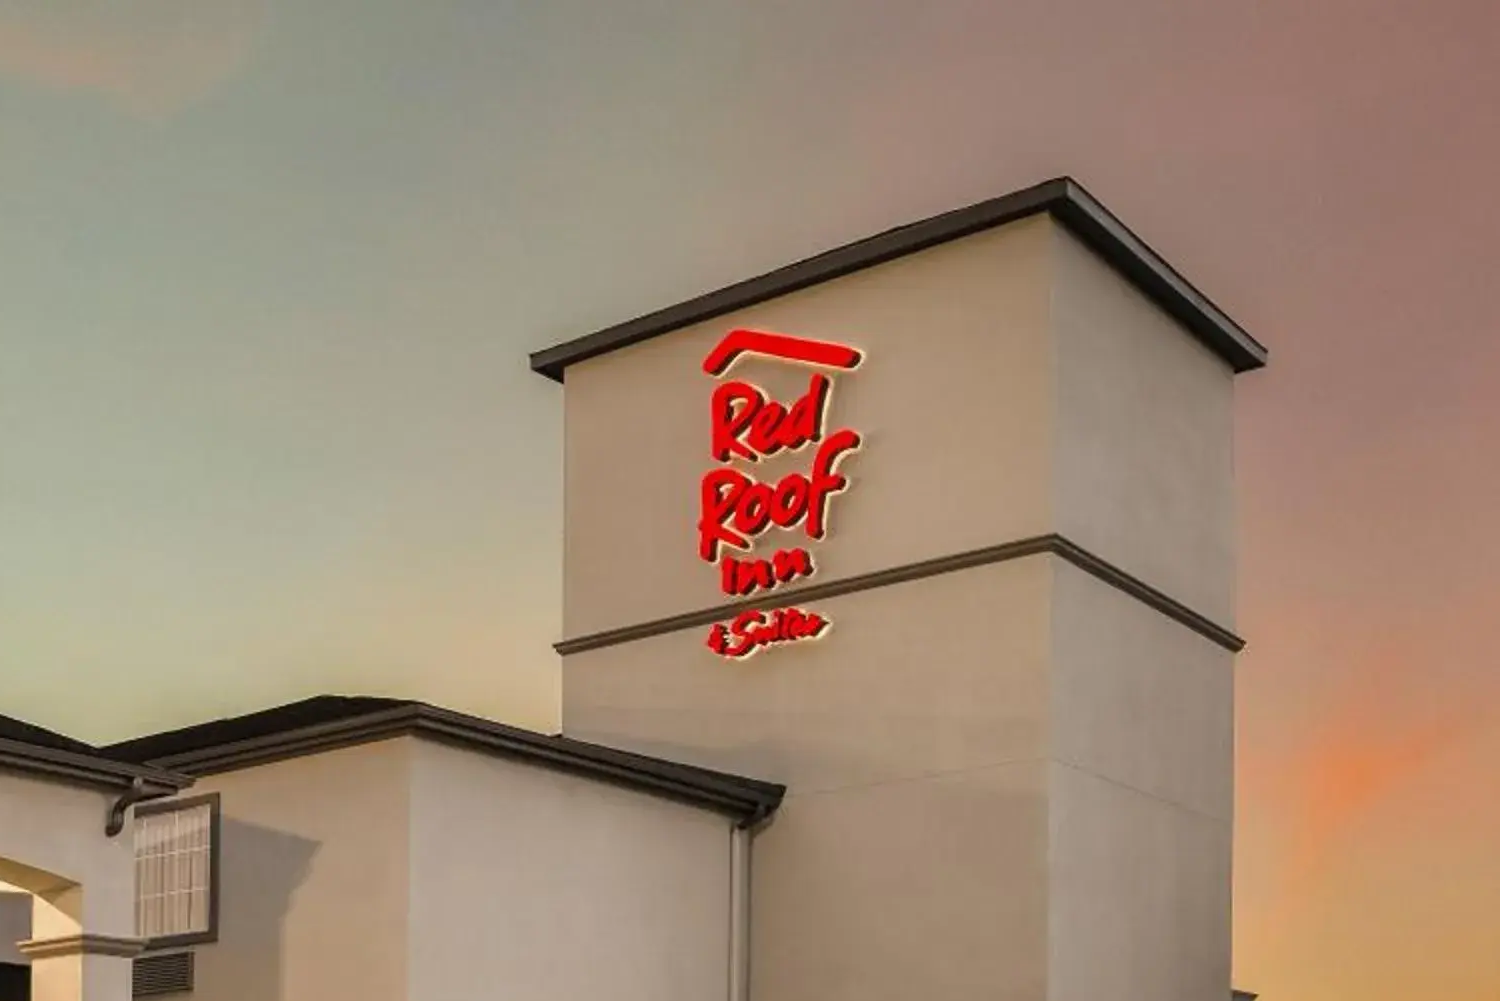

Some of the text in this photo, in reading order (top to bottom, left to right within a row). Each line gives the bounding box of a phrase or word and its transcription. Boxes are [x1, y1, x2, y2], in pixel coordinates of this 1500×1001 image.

[710, 373, 831, 462] Red
[698, 429, 861, 563] Roof
[721, 548, 816, 597] Inn
